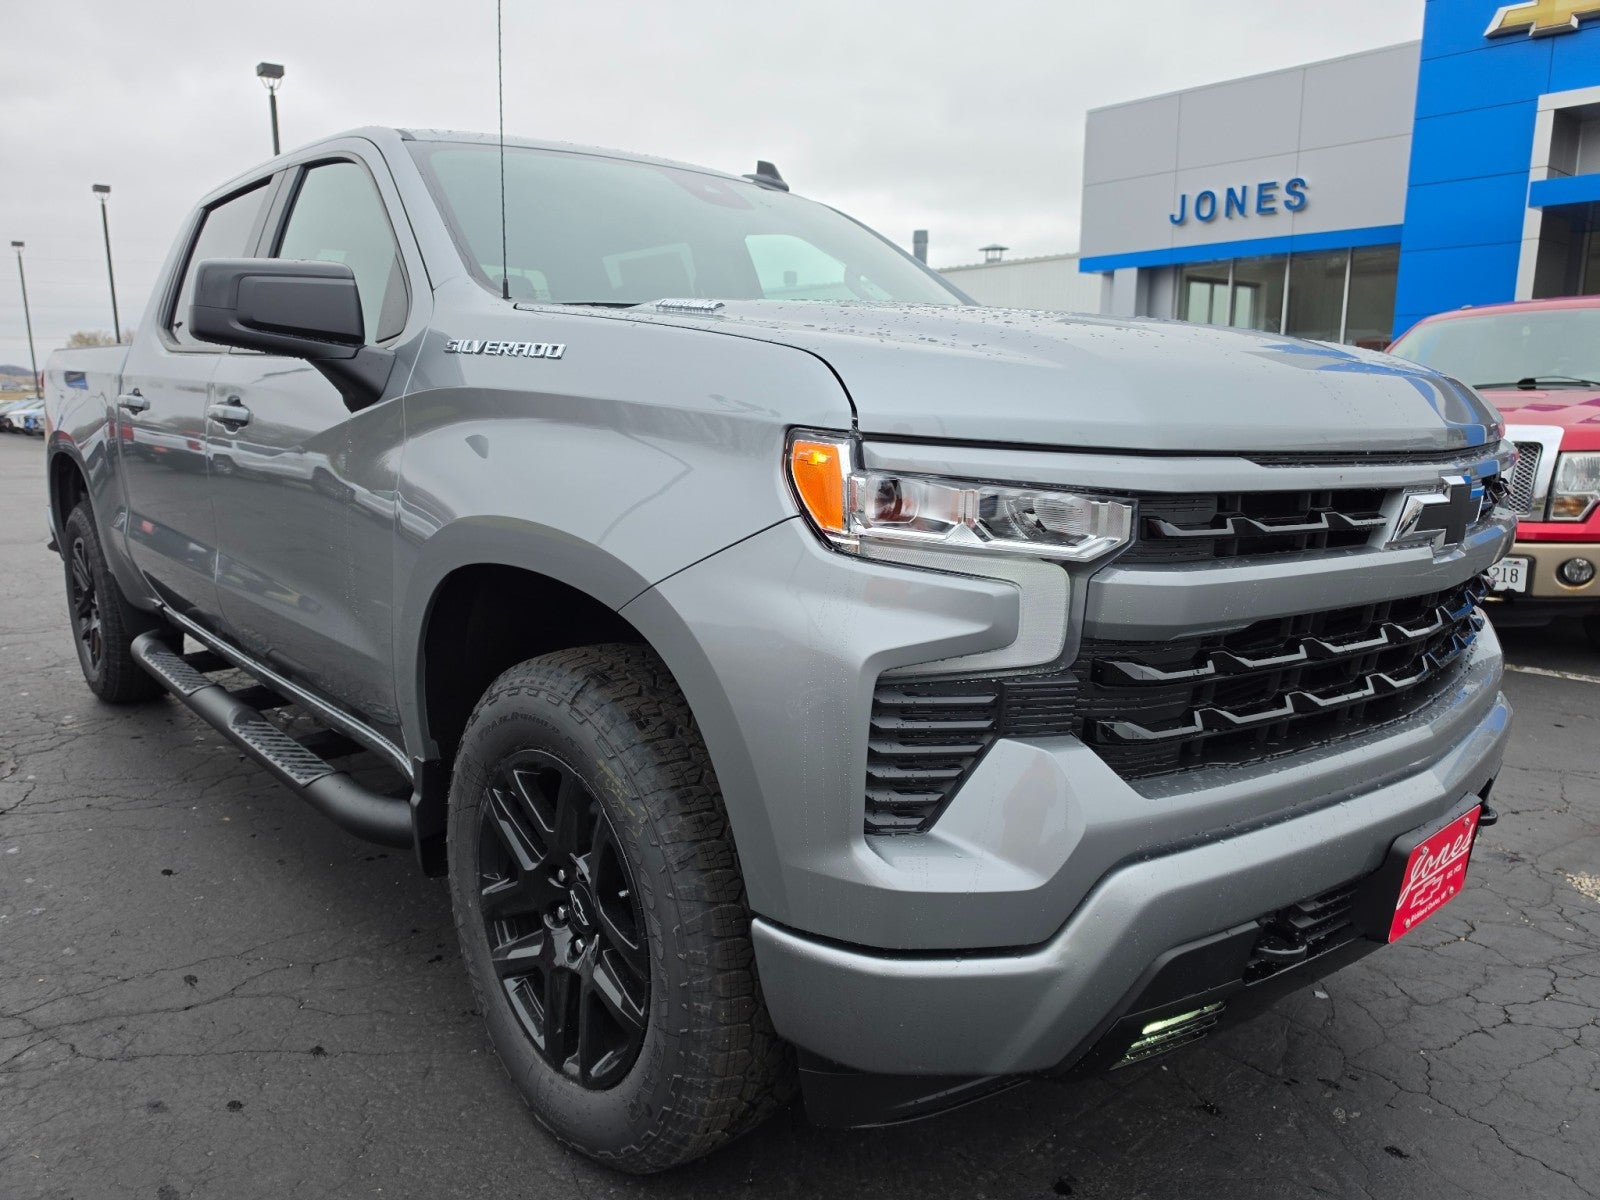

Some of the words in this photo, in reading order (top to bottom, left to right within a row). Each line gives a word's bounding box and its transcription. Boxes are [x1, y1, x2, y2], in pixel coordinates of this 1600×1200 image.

[1169, 177, 1308, 226] JONES
[444, 339, 567, 360] SILVERADO
[1492, 567, 1519, 583] 218
[1396, 823, 1475, 911] Jones
